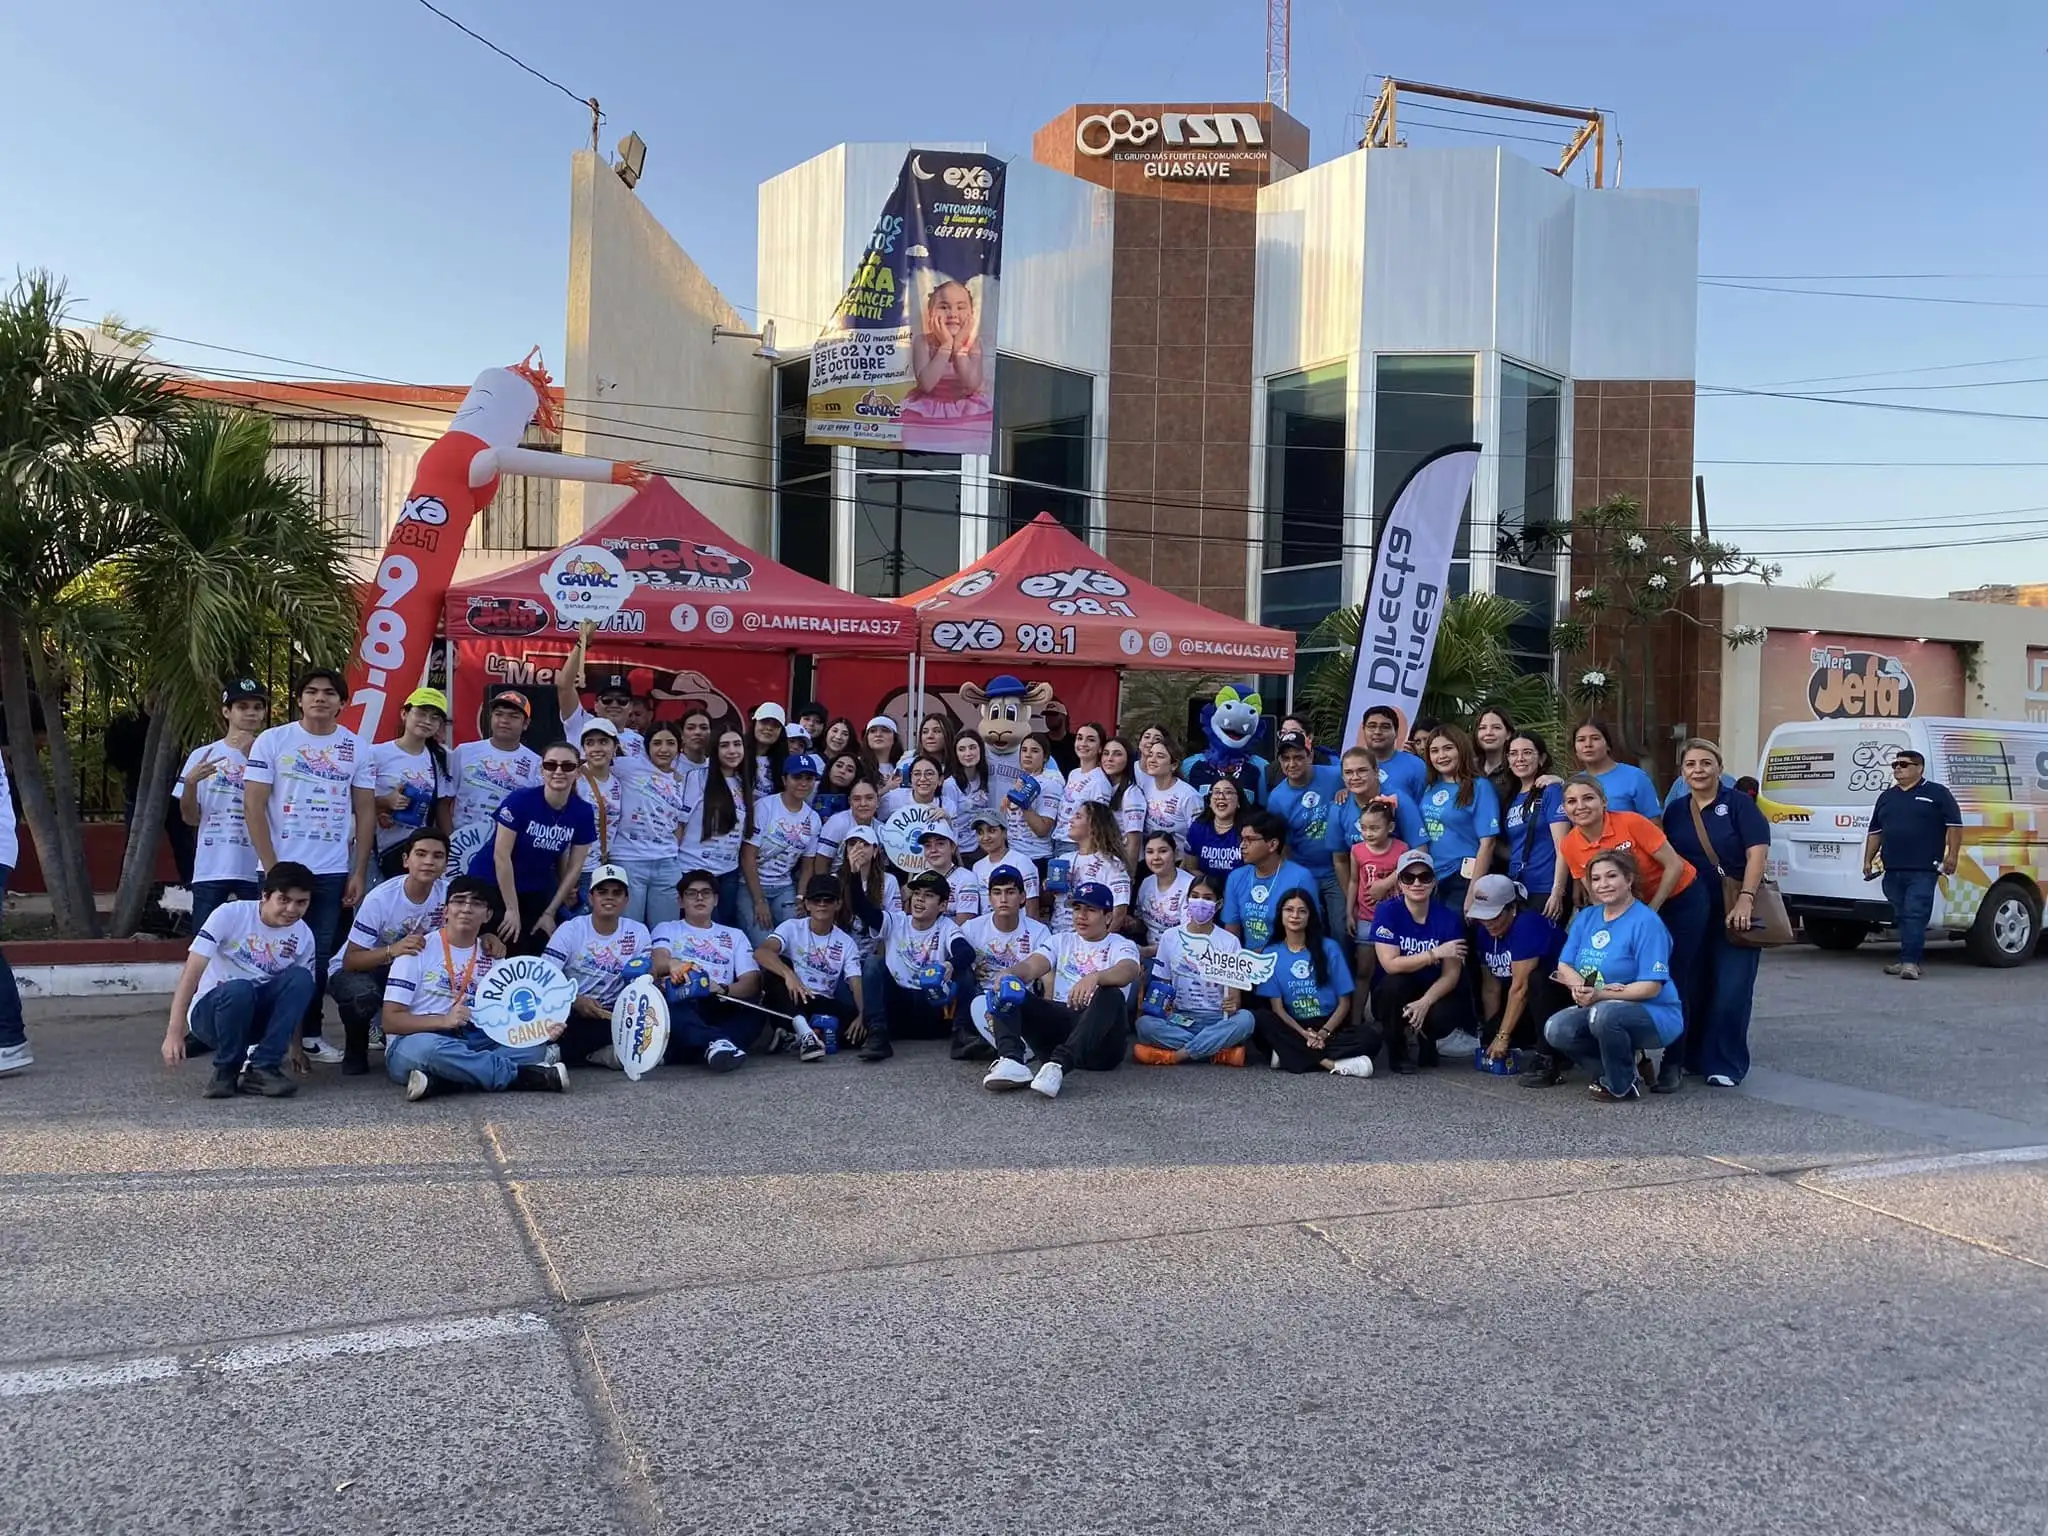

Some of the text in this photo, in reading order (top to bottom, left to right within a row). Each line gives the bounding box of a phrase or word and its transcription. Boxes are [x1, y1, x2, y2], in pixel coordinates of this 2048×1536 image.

[1114, 153, 1123, 161] EL
[1124, 153, 1150, 161] GRUPO
[1169, 152, 1196, 161] FUERTE
[1197, 152, 1208, 160] EN
[1144, 162, 1230, 177] GUASAVE
[963, 188, 990, 201] 98.1
[815, 344, 896, 365] ESTE 02 Y 03
[815, 357, 886, 378] DE OCTUBRE
[855, 403, 901, 417] GANAC
[557, 572, 618, 588] GANAC
[1048, 597, 1137, 618] 98.1
[742, 612, 901, 634] @LAMERAJEFA937
[1016, 623, 1076, 654] 98.1
[1178, 638, 1289, 660] @EXAGUASAVE
[489, 655, 508, 672] La
[1820, 654, 1851, 670] Mera
[1815, 655, 1900, 717] Jefa
[526, 820, 575, 842] RADIOTÓN
[533, 837, 562, 851] GANAC
[1201, 845, 1242, 861] RADIOTÓN
[1209, 859, 1234, 870] GANAC
[483, 960, 556, 1001] RADIOTÓN
[1204, 963, 1245, 982] Esperanza
